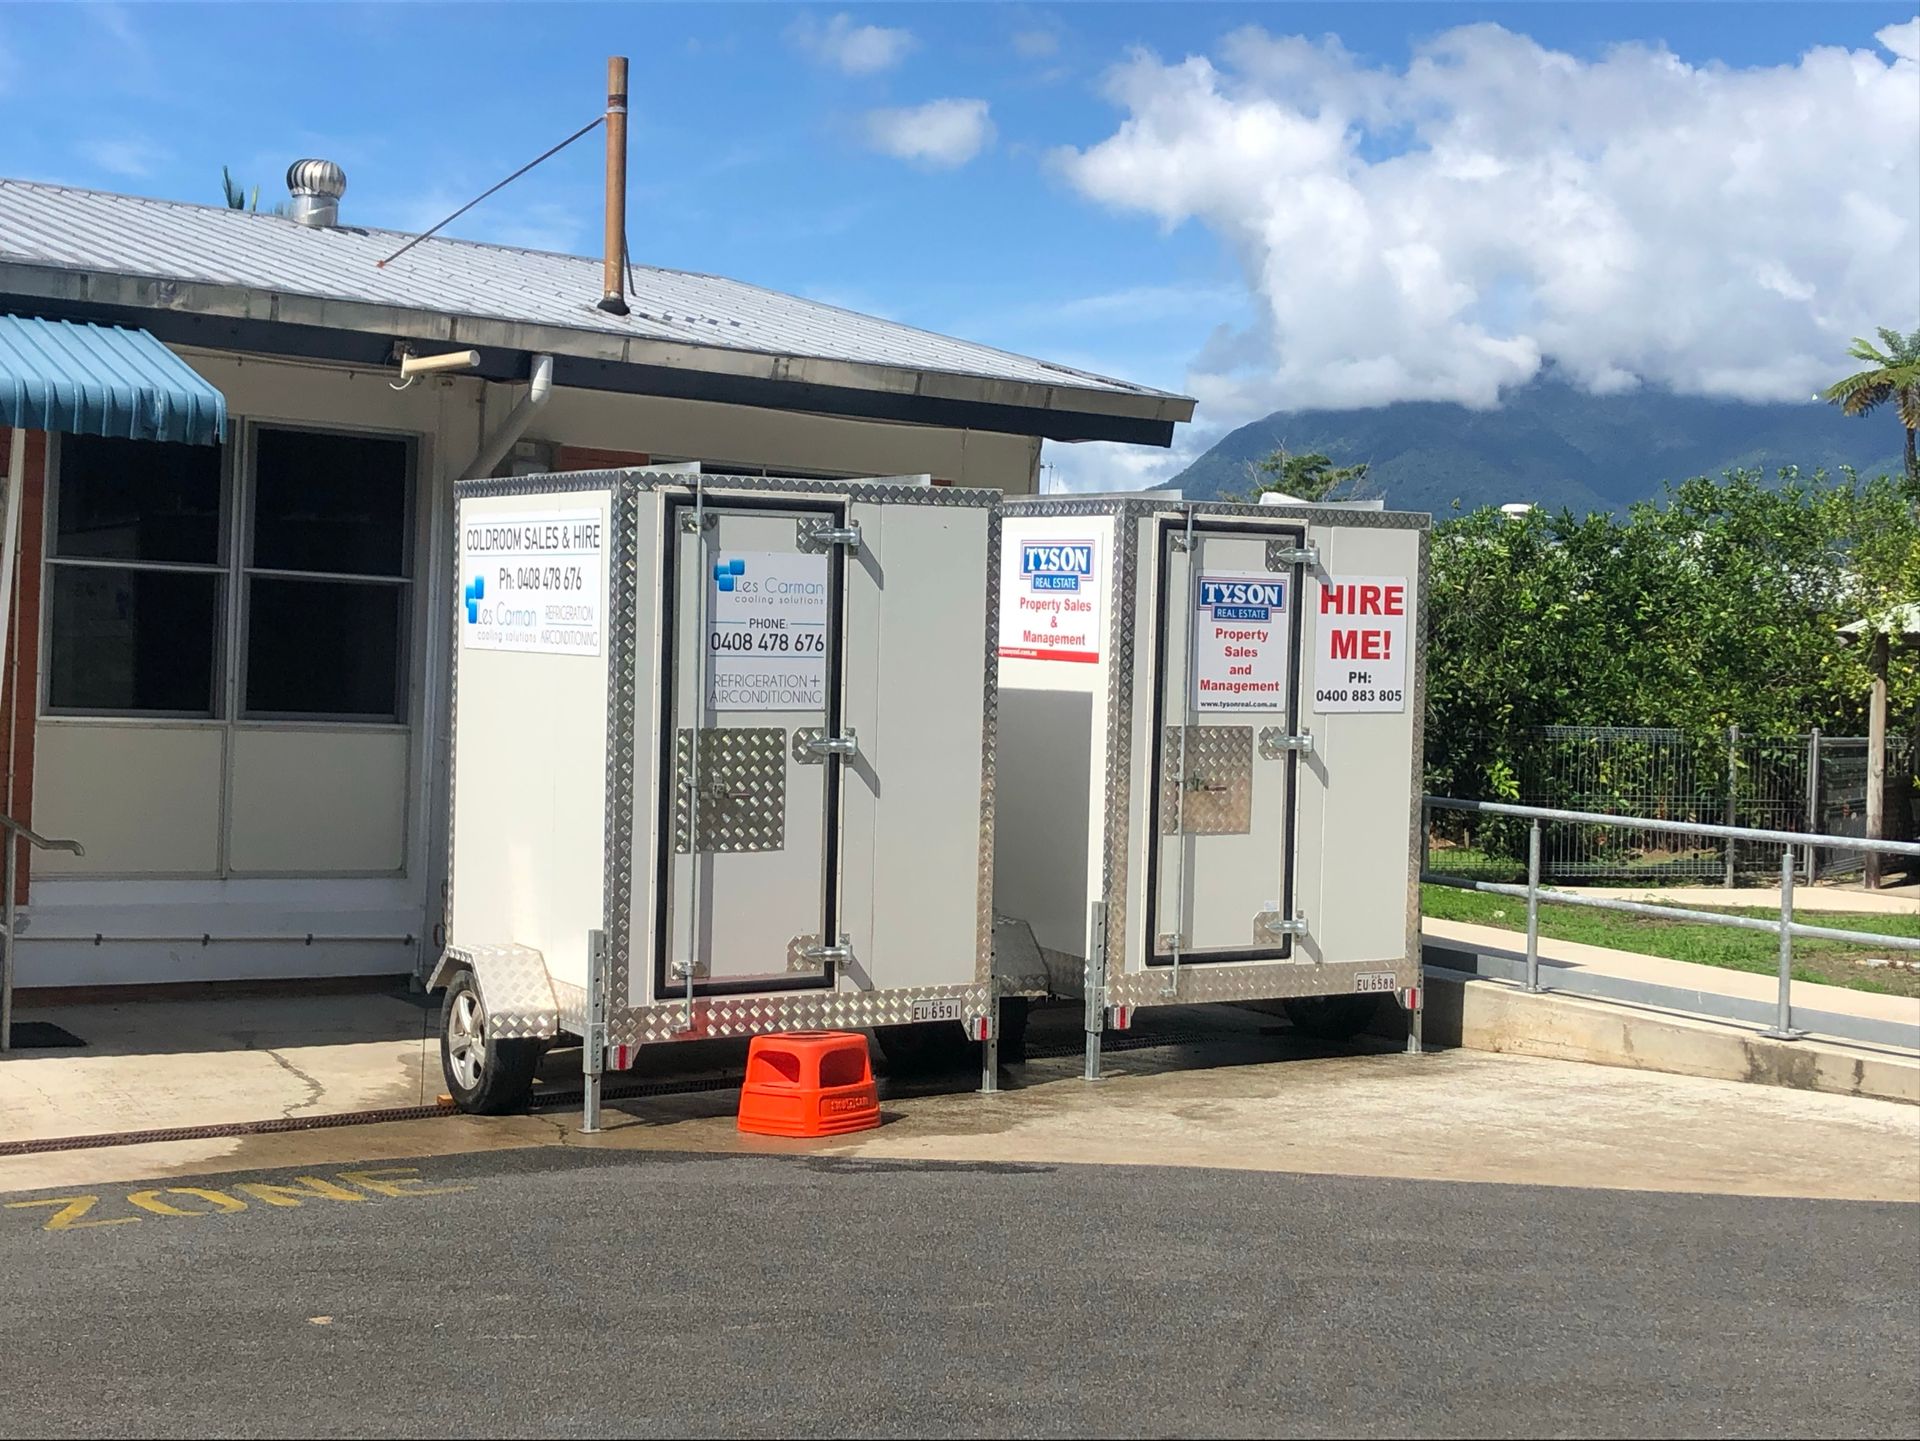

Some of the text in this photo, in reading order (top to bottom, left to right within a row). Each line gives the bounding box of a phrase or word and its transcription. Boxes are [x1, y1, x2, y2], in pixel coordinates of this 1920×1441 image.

[466, 524, 600, 551] COLDROOM SALES & HIRE
[1026, 547, 1088, 572] TYSON
[499, 566, 582, 590] Ph: 0408 478 676
[735, 577, 824, 595] Les Carman
[1035, 577, 1076, 589] REAL ESTATE
[734, 594, 824, 605] cooling solutions
[1204, 583, 1279, 605] TYSON
[1320, 584, 1404, 615] HIRE
[477, 601, 537, 626] Les Carman
[545, 604, 593, 621] REFRIGERATION
[1019, 597, 1092, 614] Property Sales
[1217, 608, 1266, 619] REAL ESTATE
[1050, 615, 1058, 628] &
[711, 632, 824, 652] 0408 478 676
[1023, 630, 1086, 647] Management
[1215, 628, 1268, 643] Property
[1224, 646, 1258, 658] Sales
[1330, 630, 1392, 660] ME!
[1229, 664, 1252, 675] and
[1348, 672, 1372, 684] PH:
[1200, 680, 1279, 694] Management
[710, 689, 823, 704] AIRCONDITIONING
[1316, 690, 1402, 702] 0400 883 805
[1200, 701, 1278, 709] www.tysonreal.com.au
[4, 1167, 477, 1230] ZONE
